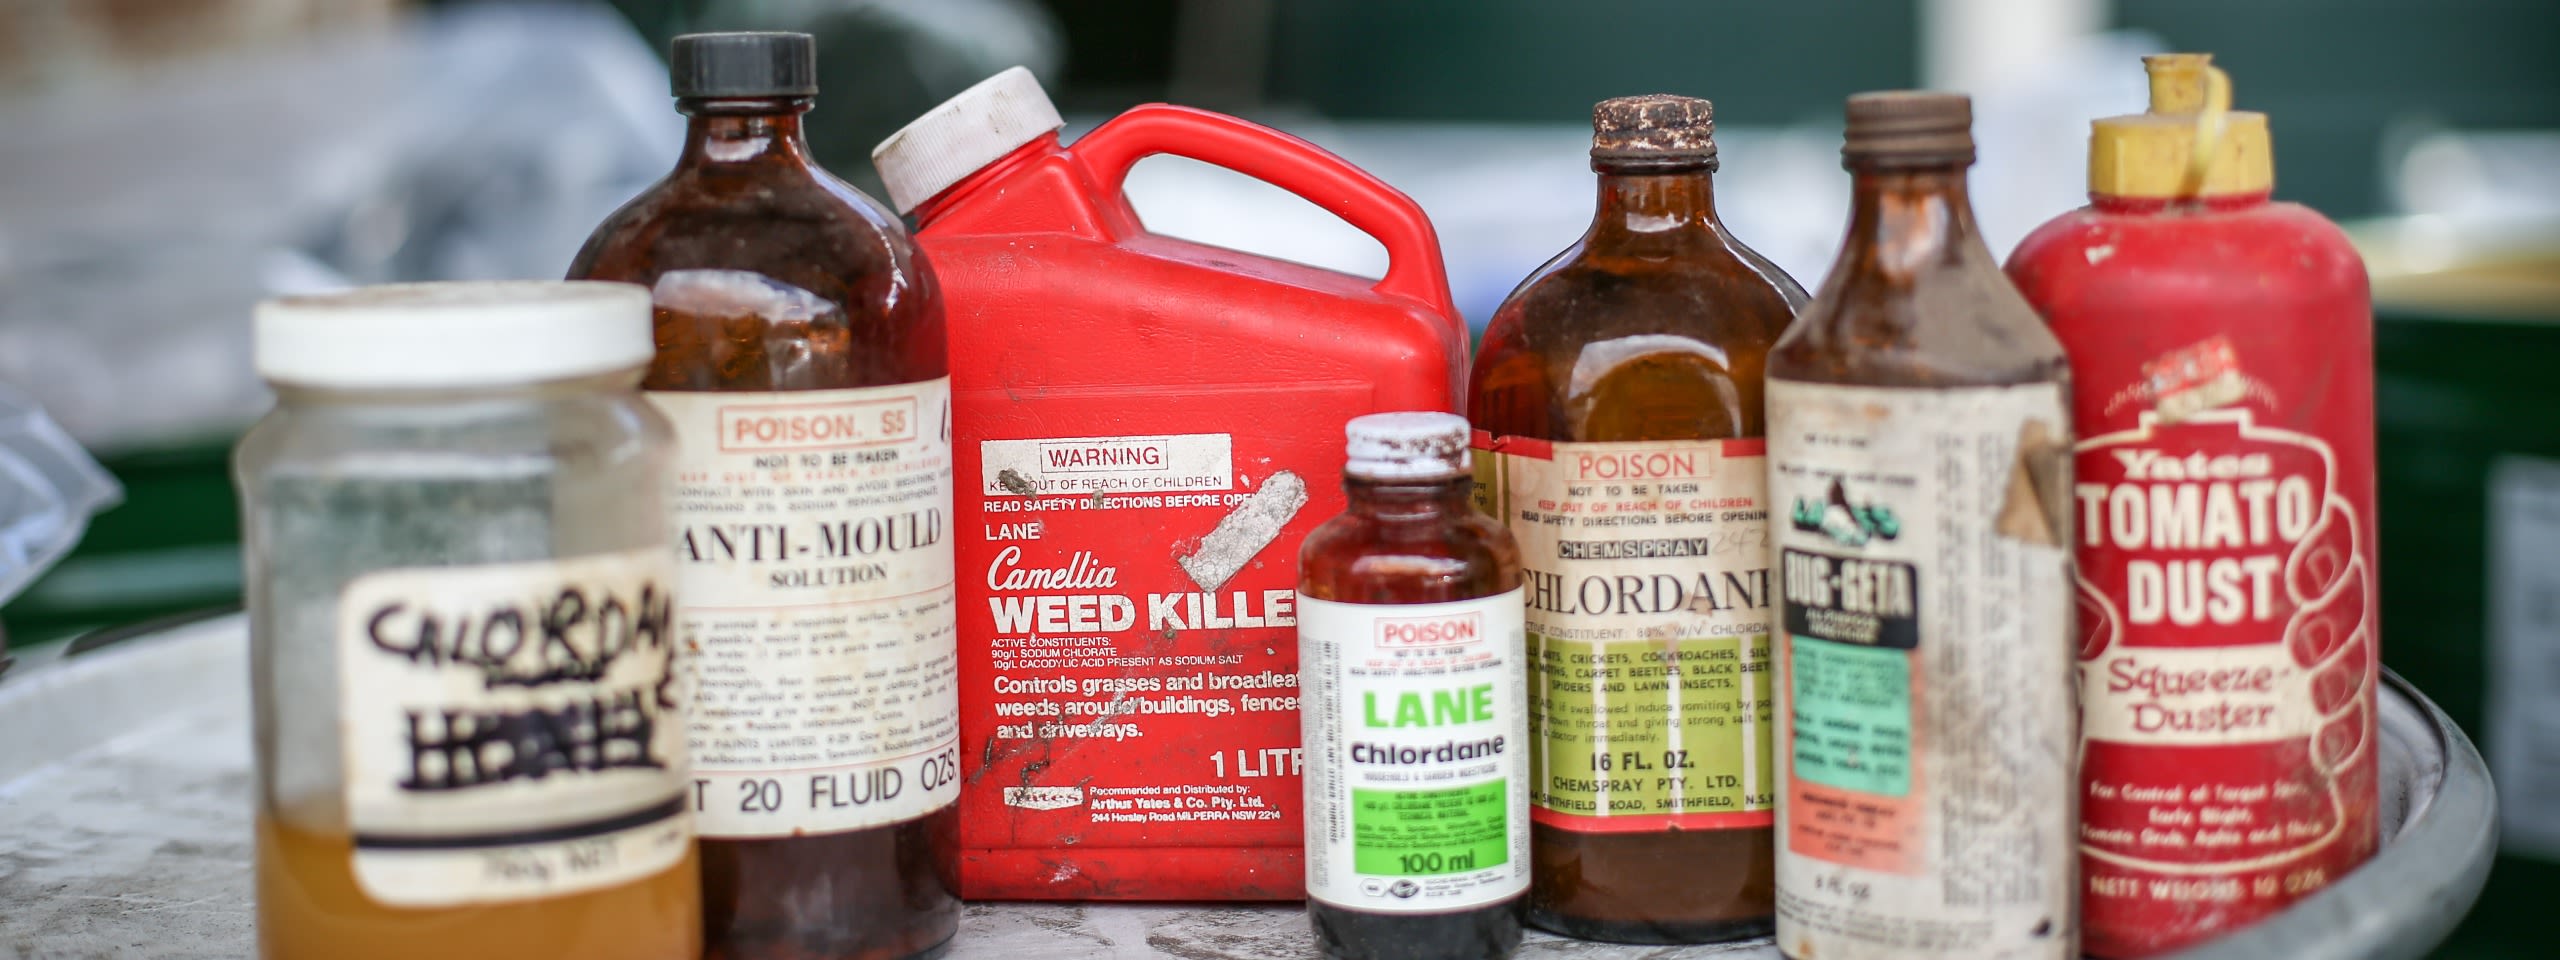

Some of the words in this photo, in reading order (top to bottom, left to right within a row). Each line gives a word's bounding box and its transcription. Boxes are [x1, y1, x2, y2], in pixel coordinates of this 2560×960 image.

[736, 416, 862, 442] POISON.
[881, 410, 906, 435] S5
[1048, 447, 1159, 467] WARNING
[1579, 452, 1695, 479] POISON
[2111, 449, 2272, 480] Yates
[990, 480, 1027, 491] KE
[1029, 480, 1055, 490] OUT
[1060, 479, 1078, 490] OF
[1081, 478, 1128, 489] REACH
[1132, 477, 1151, 488] OF
[1154, 476, 1222, 488] CHILDREN
[1568, 487, 1592, 497] NOT
[1605, 486, 1621, 496] TO
[1632, 485, 1646, 495] BE
[1657, 484, 1698, 496] TAKEN
[984, 500, 1021, 513] READ
[1024, 498, 1076, 511] SAFETY
[1166, 495, 1220, 507] BEFORE
[1561, 502, 1583, 512] OUT
[1591, 502, 1608, 512] OF
[1616, 502, 1657, 512] REACH
[1665, 501, 1682, 511] OF
[1689, 498, 1753, 511] CHILDREN
[2076, 474, 2311, 550] TOMATO
[1522, 510, 1539, 522] READ
[1542, 513, 1574, 526] SAFETY
[1582, 515, 1657, 526] DIRECTIONS
[1665, 512, 1713, 524] BEFORE
[1721, 510, 1768, 522] OPENIN
[680, 507, 941, 562] ANTI-MOULD
[985, 523, 1041, 541] LANE
[1558, 538, 1708, 560] CHEMSPRAY
[770, 563, 888, 588] SOLUTION
[987, 545, 1118, 591] Camellia
[2127, 555, 2280, 626] DUST
[988, 594, 1136, 634] WEED
[1147, 589, 1296, 631] KILLE
[1384, 620, 1474, 643] POISON
[1711, 622, 1769, 635] CHLORDA
[991, 639, 1027, 648] ACTIVE
[1030, 637, 1112, 648] CONSTITUENTS:
[991, 649, 1018, 660] 90g/L
[1020, 649, 1061, 658] SODIUM
[1064, 648, 1117, 657] CHLORATE
[992, 660, 1019, 670] 10g/L
[1019, 659, 1079, 668] CACODYLIC
[1081, 658, 1104, 668] ACID
[1107, 657, 1156, 667] PRESENT
[1158, 657, 1172, 666] AS
[1174, 656, 1216, 665] SODIUM
[1218, 655, 1244, 664] SALT
[1570, 653, 1632, 665] CRICKETS,
[1640, 649, 1739, 662] COCKROACHES,
[1575, 668, 1620, 679] CARPET
[1629, 665, 1685, 678] BEETLES,
[1692, 664, 1733, 676] BLACK
[993, 675, 1077, 694] Controls
[1082, 675, 1161, 697] grasses
[1165, 672, 1203, 691] and
[1552, 679, 1592, 693] SPIDERS
[1600, 682, 1626, 693] AND
[1634, 680, 1670, 692] LAWN
[1679, 678, 1735, 690] INSECTS.
[995, 699, 1061, 716] weeds
[1064, 699, 1139, 716] around
[1140, 695, 1236, 717] buildings,
[1363, 683, 1493, 728] LANE
[1570, 702, 1628, 714] swallowed
[1635, 700, 1673, 712] induce
[1681, 700, 1731, 712] vomiting
[1736, 698, 1751, 711] by
[1576, 718, 1609, 729] throat
[1616, 716, 1638, 728] and
[1644, 716, 1680, 730] giving
[1688, 716, 1725, 727] strong
[1732, 713, 1752, 724] salt
[2127, 701, 2276, 733] Duster
[997, 721, 1034, 739] and
[1038, 720, 1143, 742] driveways.
[1585, 731, 1660, 744] immediately.
[1352, 734, 1505, 765] Chlordane
[1209, 750, 1225, 778] 1
[1238, 748, 1303, 778] LITR
[1591, 752, 1612, 771] 16
[1622, 751, 1652, 770] FL.
[1663, 750, 1695, 769] OZ.
[740, 778, 782, 813] 20
[810, 767, 902, 808] FLUID
[1090, 786, 1161, 796] Recommended
[1163, 785, 1181, 795] and
[1183, 785, 1234, 794] Distributed
[1236, 785, 1250, 795] by:
[1553, 776, 1643, 793] CHEMSPRAY
[1657, 777, 1694, 792] PTY.
[1706, 774, 1741, 789] LTD.
[1091, 798, 1132, 810] Arthur
[1135, 798, 1171, 809] Yates
[1174, 797, 1183, 809] &
[1186, 797, 1207, 809] Co.
[1212, 796, 1236, 810] Pty.
[1239, 796, 1264, 808] Ltd.
[1608, 800, 1646, 812] ROAD,
[1656, 796, 1735, 810] SMITHFIELD,
[1091, 813, 1109, 822] 244
[1149, 812, 1175, 822] Road
[1176, 811, 1229, 821] MILPERRA
[1232, 811, 1256, 820] NSW
[1258, 810, 1280, 820] 2214
[1400, 852, 1443, 873] 100
[1449, 848, 1474, 870] ml
